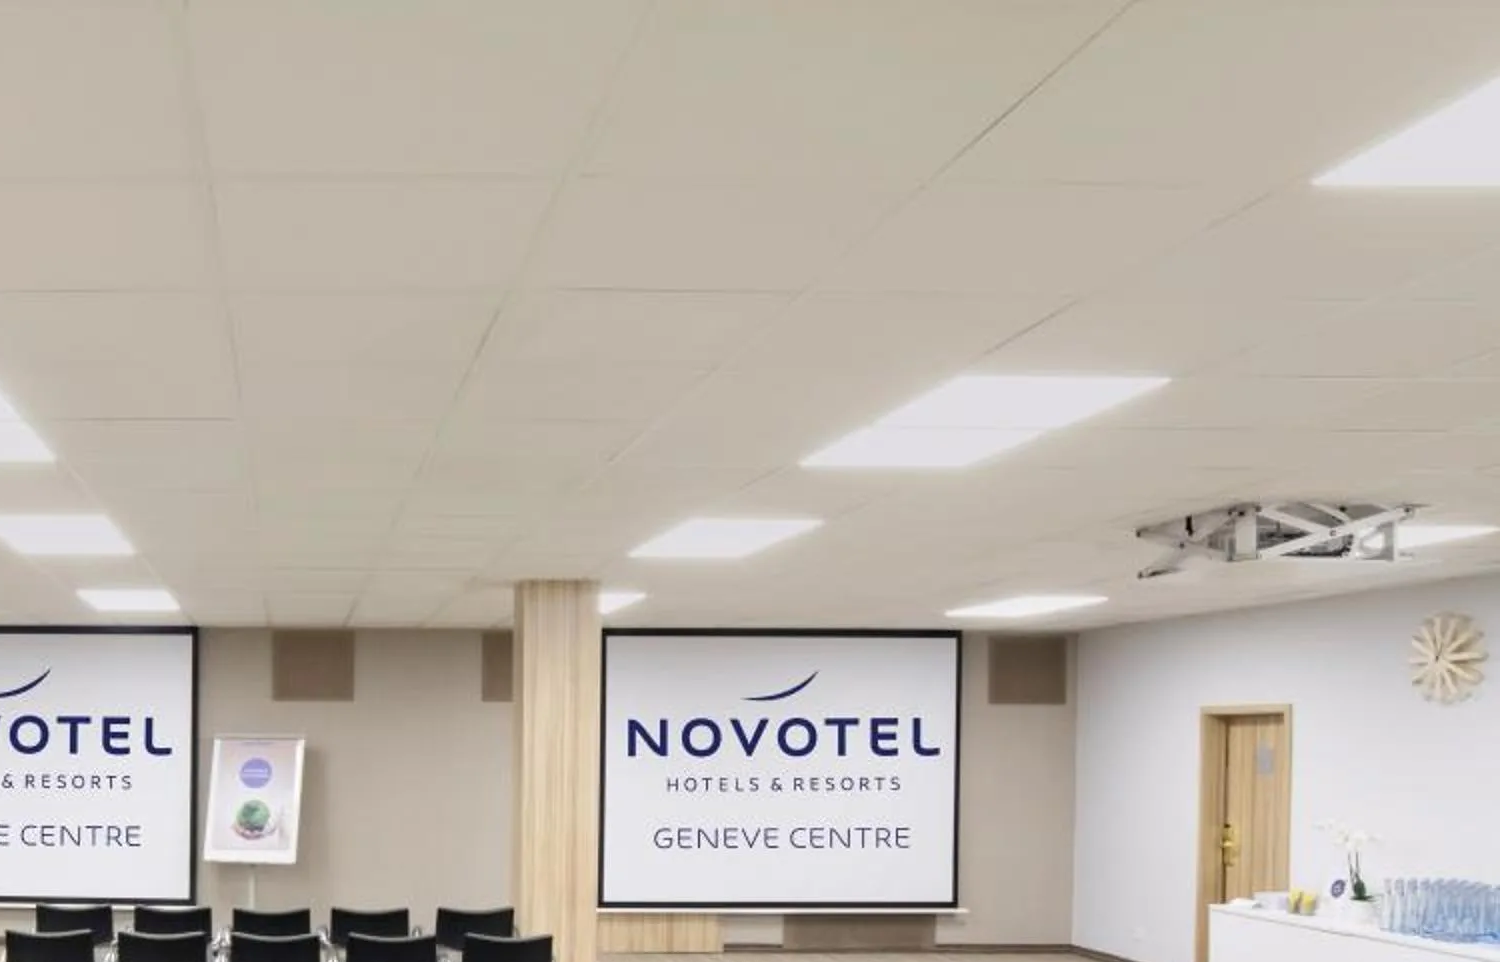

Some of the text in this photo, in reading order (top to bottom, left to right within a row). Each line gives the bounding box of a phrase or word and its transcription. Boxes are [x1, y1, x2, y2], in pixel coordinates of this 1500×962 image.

[626, 716, 942, 758] NOVOTEL
[0, 772, 15, 790] &
[24, 773, 133, 791] RESORTS
[666, 775, 901, 793] HOTELS & RESORTS
[19, 824, 142, 848] CENTRE
[652, 826, 911, 850] GENEVE CENTRE
